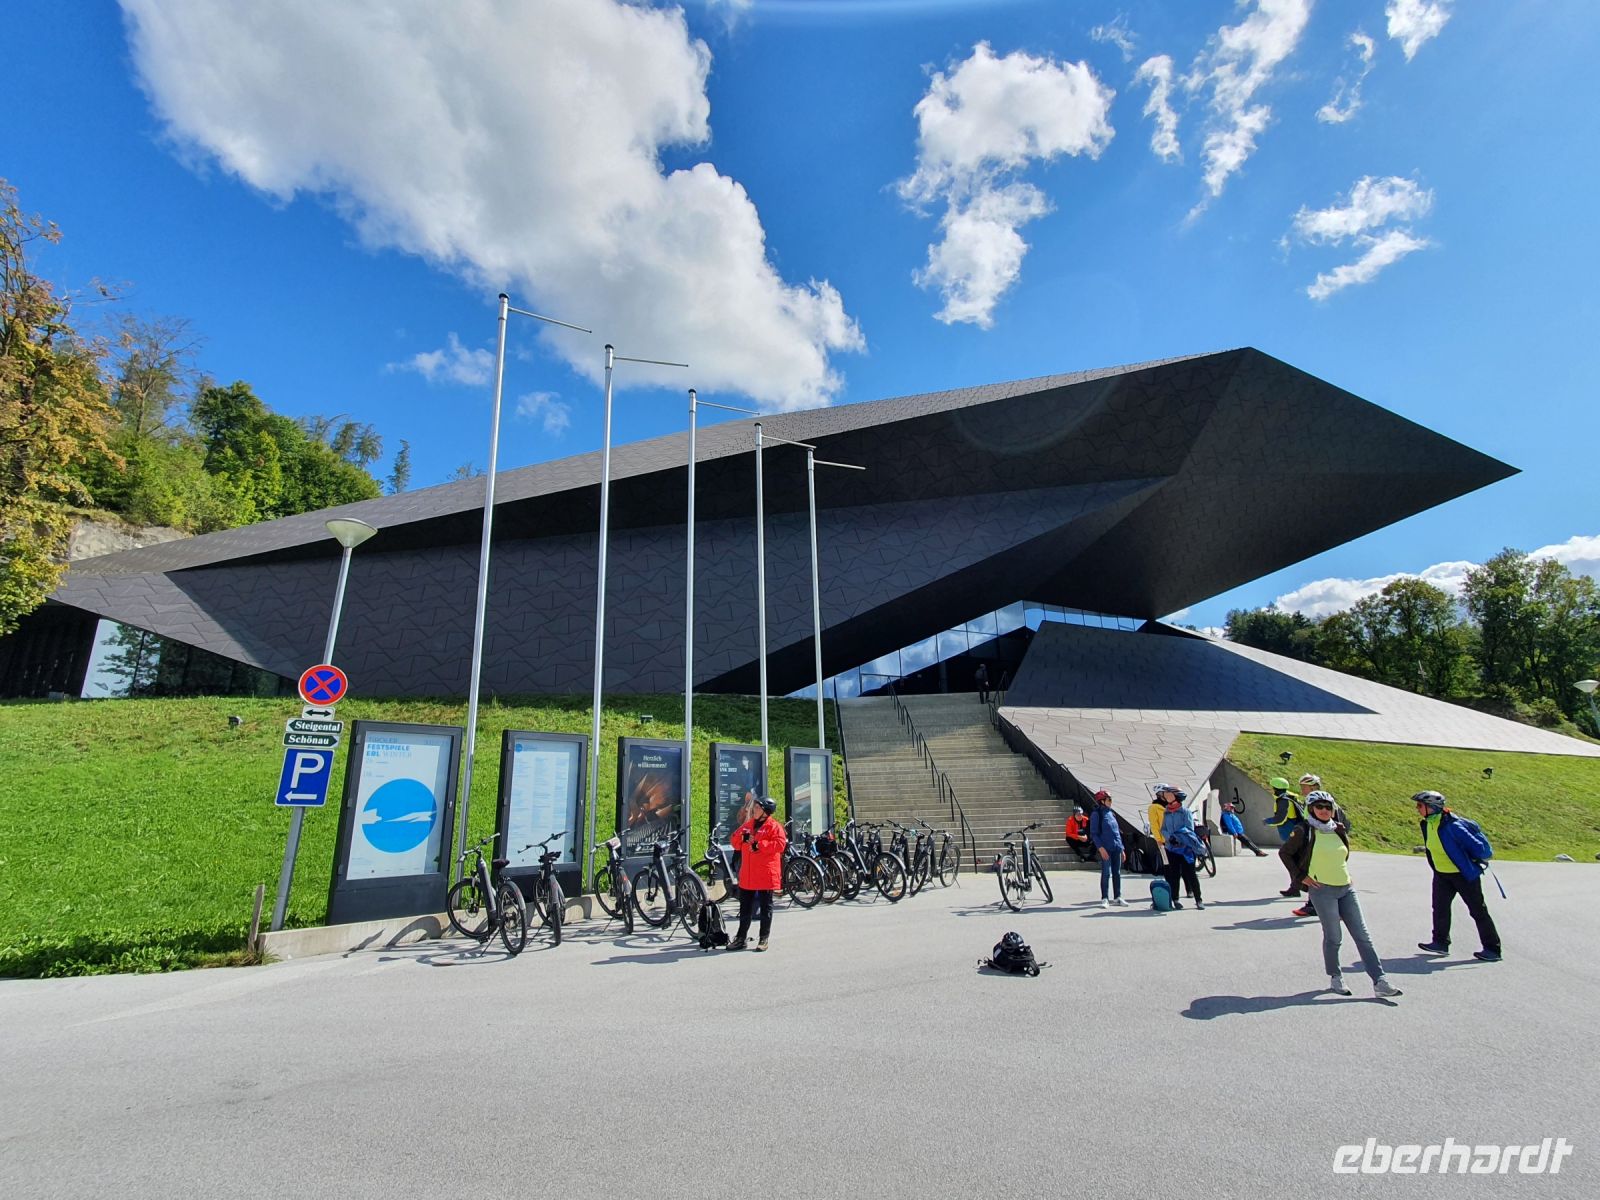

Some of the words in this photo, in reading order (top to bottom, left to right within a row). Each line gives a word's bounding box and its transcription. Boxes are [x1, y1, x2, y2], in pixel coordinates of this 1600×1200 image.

[294, 720, 341, 732] Steigental
[288, 734, 329, 745] Schönau
[290, 752, 325, 789] P
